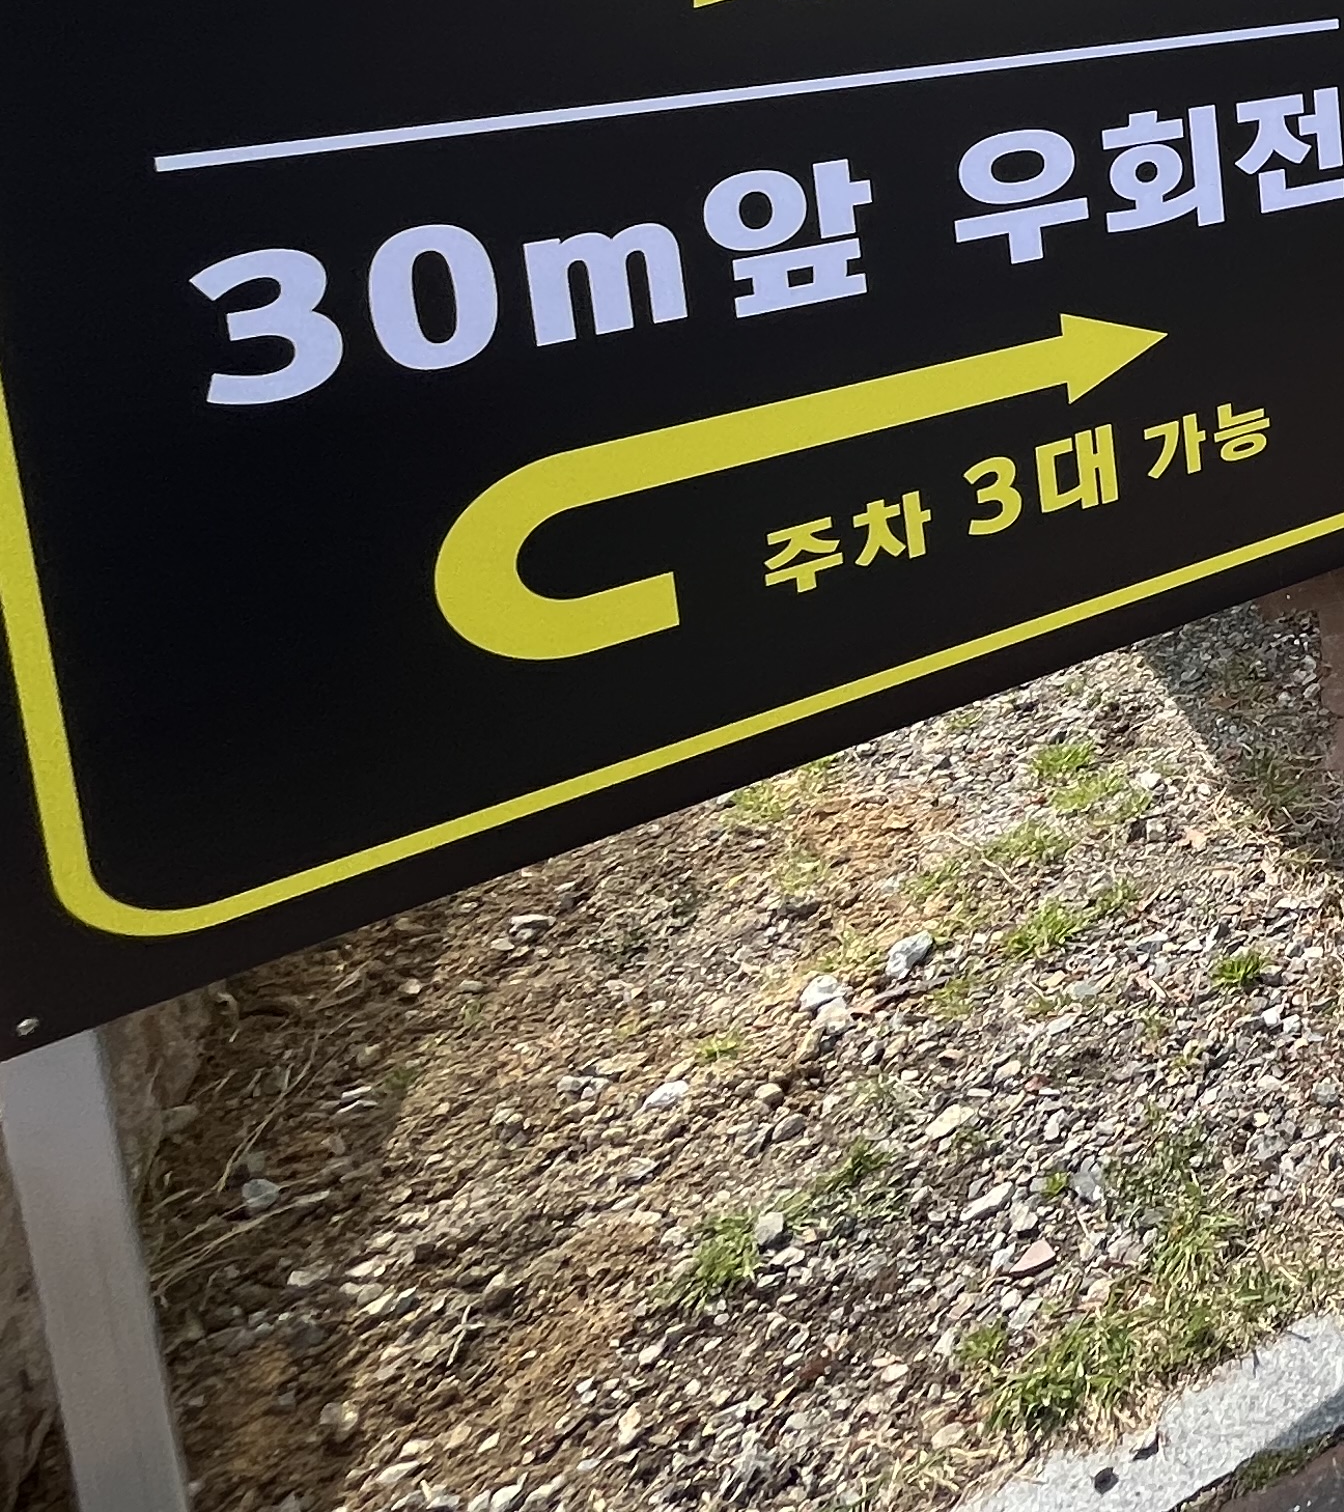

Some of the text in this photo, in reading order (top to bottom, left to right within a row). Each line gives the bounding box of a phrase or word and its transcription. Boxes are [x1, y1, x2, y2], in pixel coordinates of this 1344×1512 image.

[190, 158, 875, 406] 30m앞
[762, 402, 1270, 593] 주차 3대 가능
